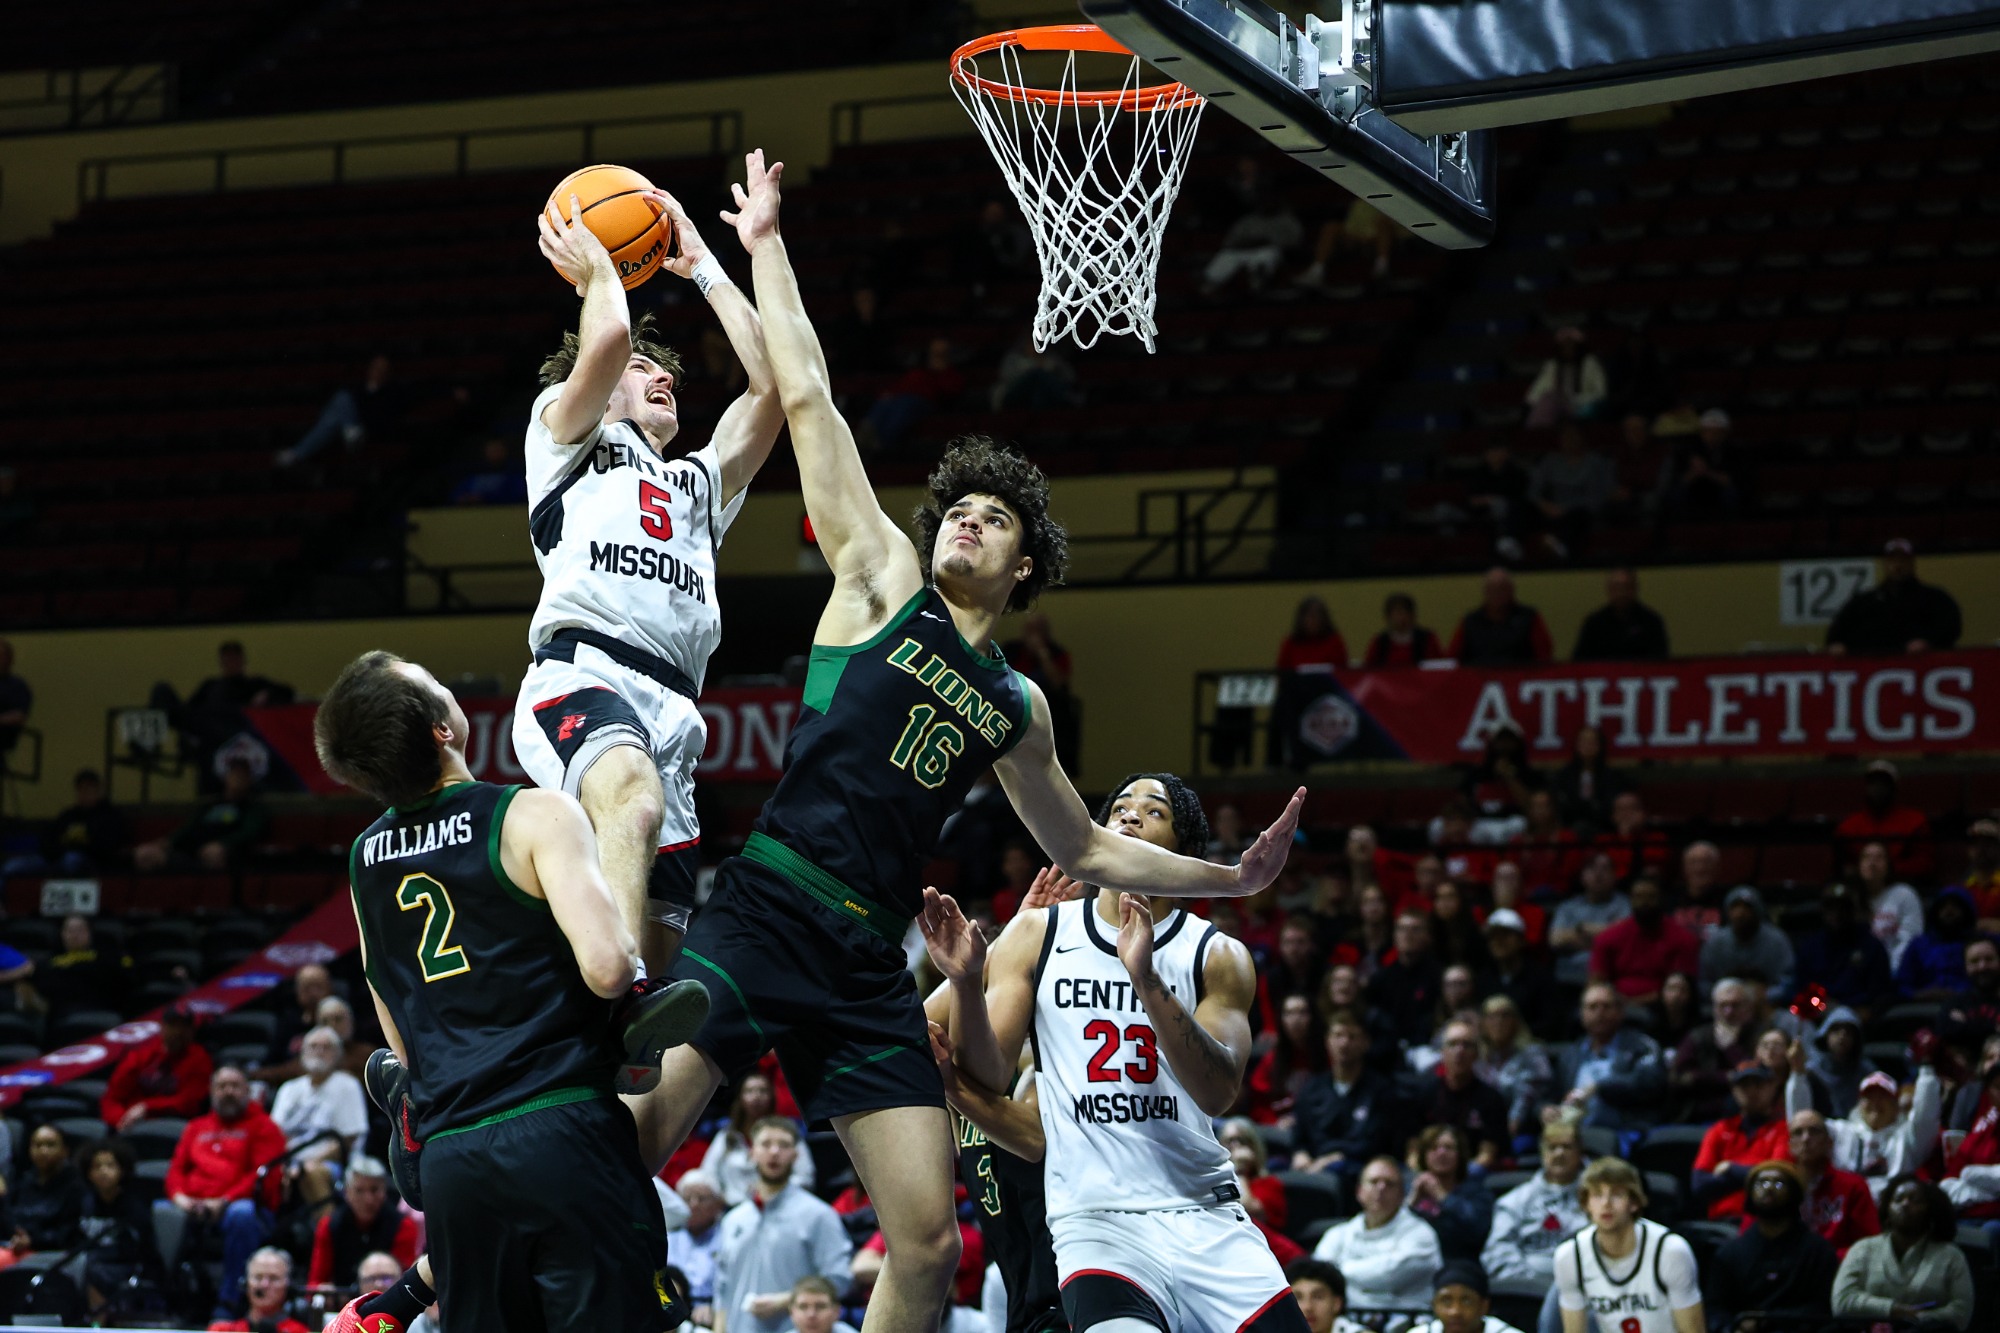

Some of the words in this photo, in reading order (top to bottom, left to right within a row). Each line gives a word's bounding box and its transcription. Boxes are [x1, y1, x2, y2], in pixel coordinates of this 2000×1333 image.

[619, 239, 664, 279] lson
[638, 479, 673, 542] 5
[590, 540, 706, 605] MISSOURI
[886, 637, 1013, 748] LIONS
[1457, 666, 1977, 751] ATHLETICS
[889, 703, 965, 789] 16
[363, 811, 473, 867] WILLIAMS
[395, 871, 471, 983] 2
[1054, 978, 1177, 1013] CENT
[1083, 1018, 1159, 1084] 23
[1072, 1093, 1179, 1124] MISSOURI
